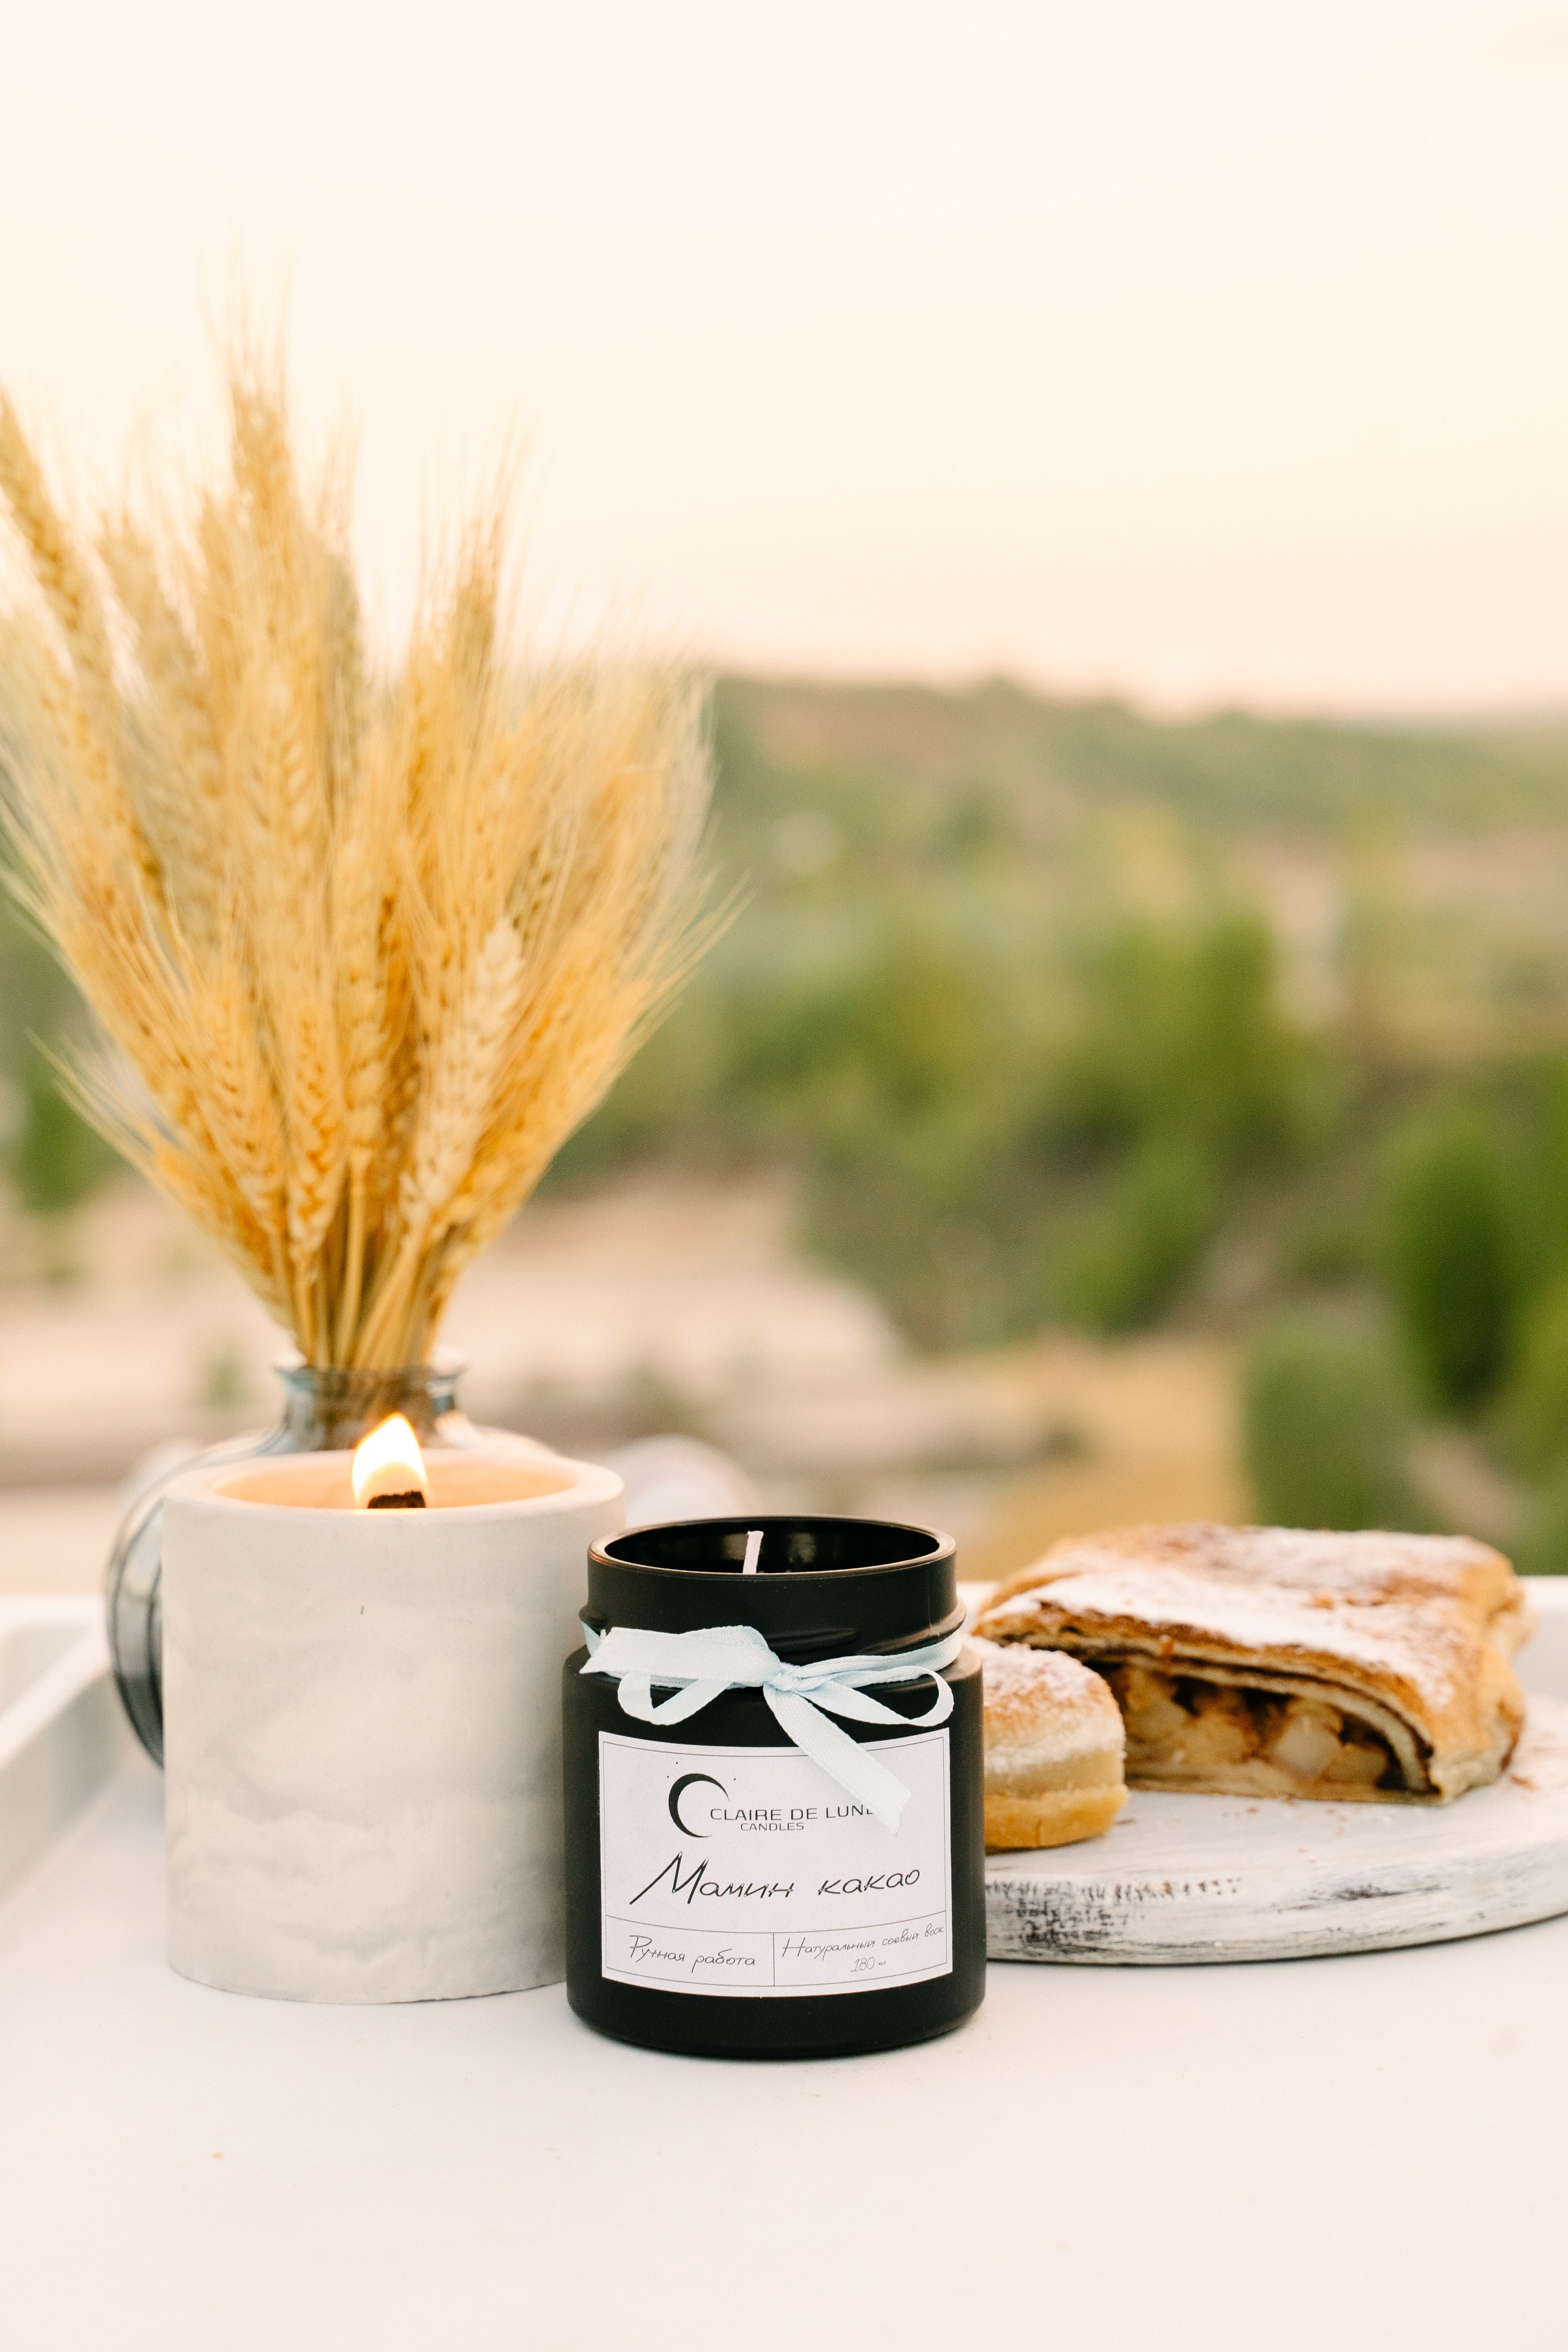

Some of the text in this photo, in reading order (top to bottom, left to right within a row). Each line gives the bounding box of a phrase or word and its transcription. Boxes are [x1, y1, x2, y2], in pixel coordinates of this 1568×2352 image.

[710, 1808, 782, 1821] CLAIRE
[791, 1807, 818, 1820] DE
[740, 1822, 805, 1831] CANDLES
[628, 1851, 921, 1905] Мамин какао
[629, 1934, 755, 1973] Ручная работа
[782, 1923, 944, 1961] Натуральный соевый воск
[850, 1956, 875, 1972] 180
